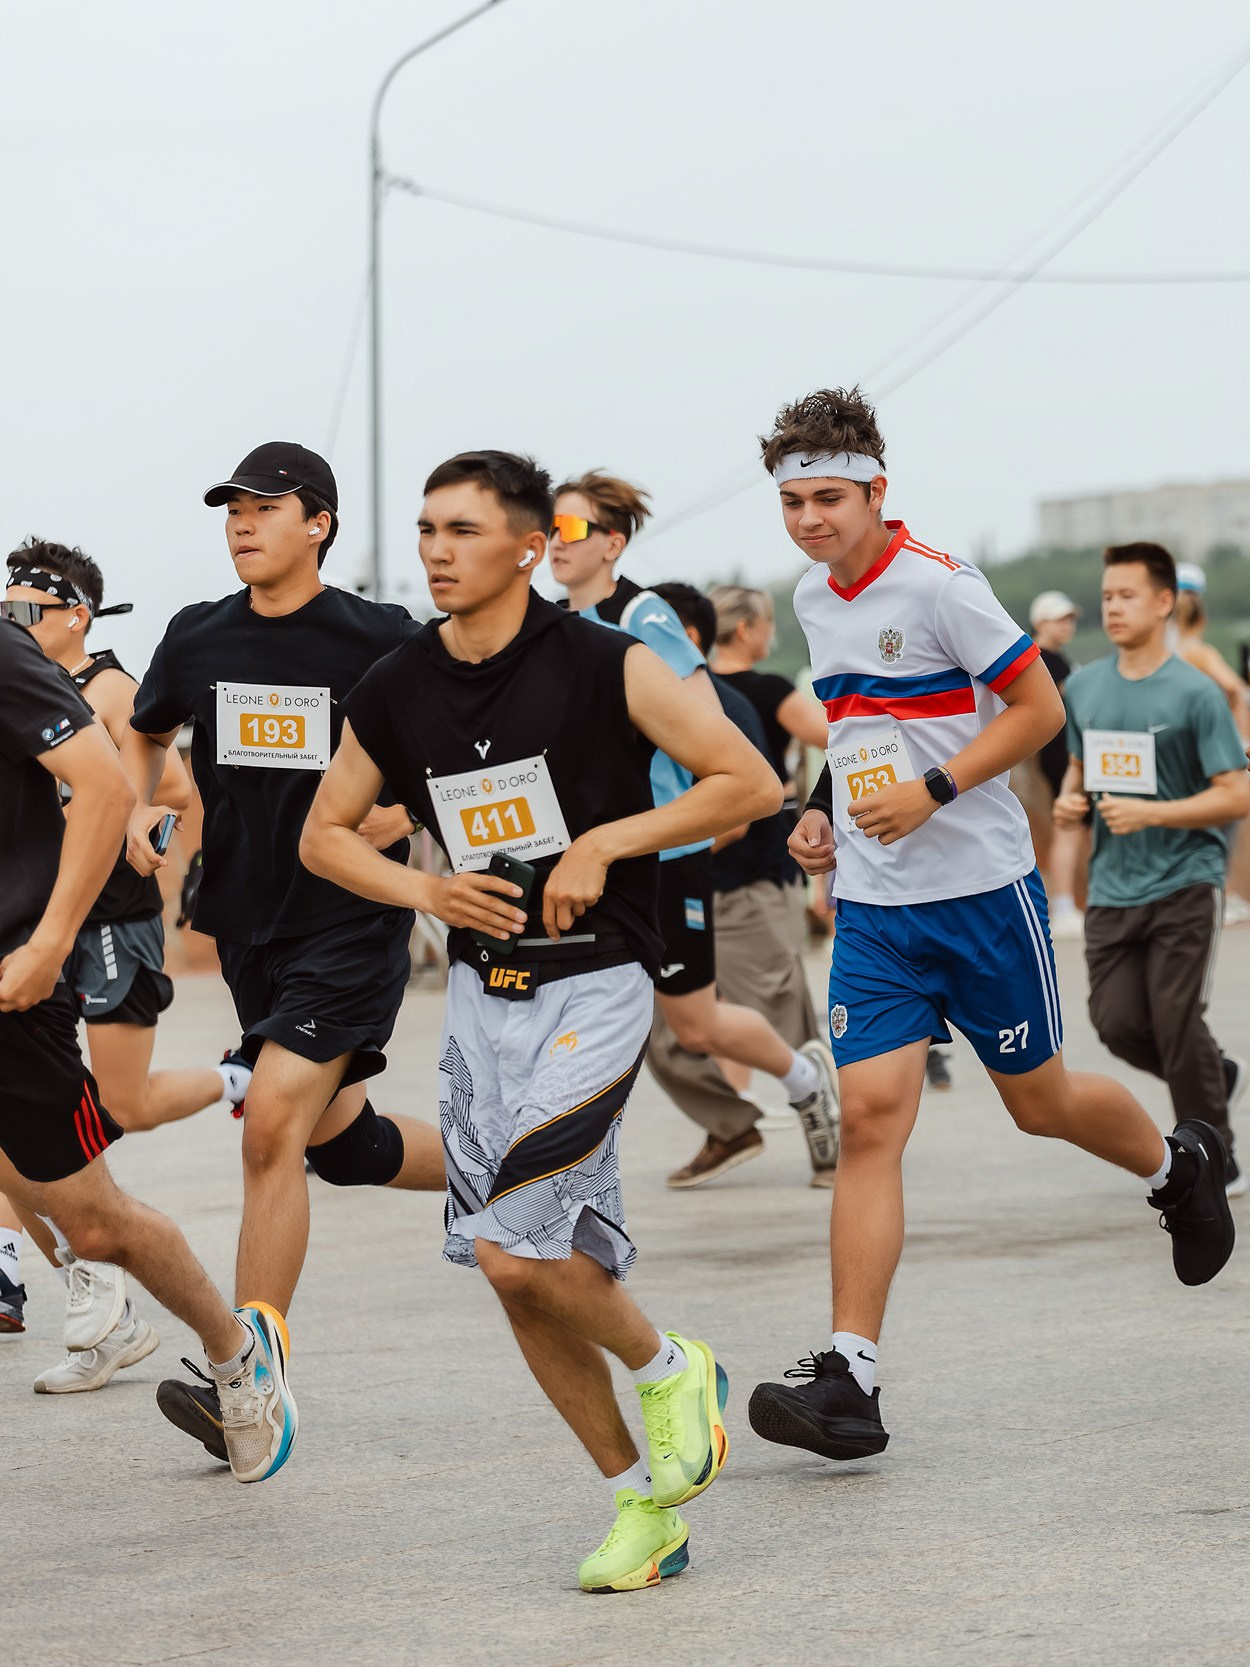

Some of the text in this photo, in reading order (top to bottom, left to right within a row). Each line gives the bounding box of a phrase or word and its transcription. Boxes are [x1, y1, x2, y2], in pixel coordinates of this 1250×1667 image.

[226, 693, 320, 708] LEONE D'ORO
[247, 717, 299, 745] 193
[228, 749, 319, 761] БЛАГОТВОРИТЕЛЬНЫЙ ЗАБЕГ
[833, 743, 899, 769] LEONE D'ORO
[440, 771, 537, 802] LEONE D'ORO
[471, 803, 523, 840] 411
[534, 836, 555, 847] ЗАБЕГ
[490, 967, 531, 990] UFC
[999, 1020, 1029, 1053] 27
